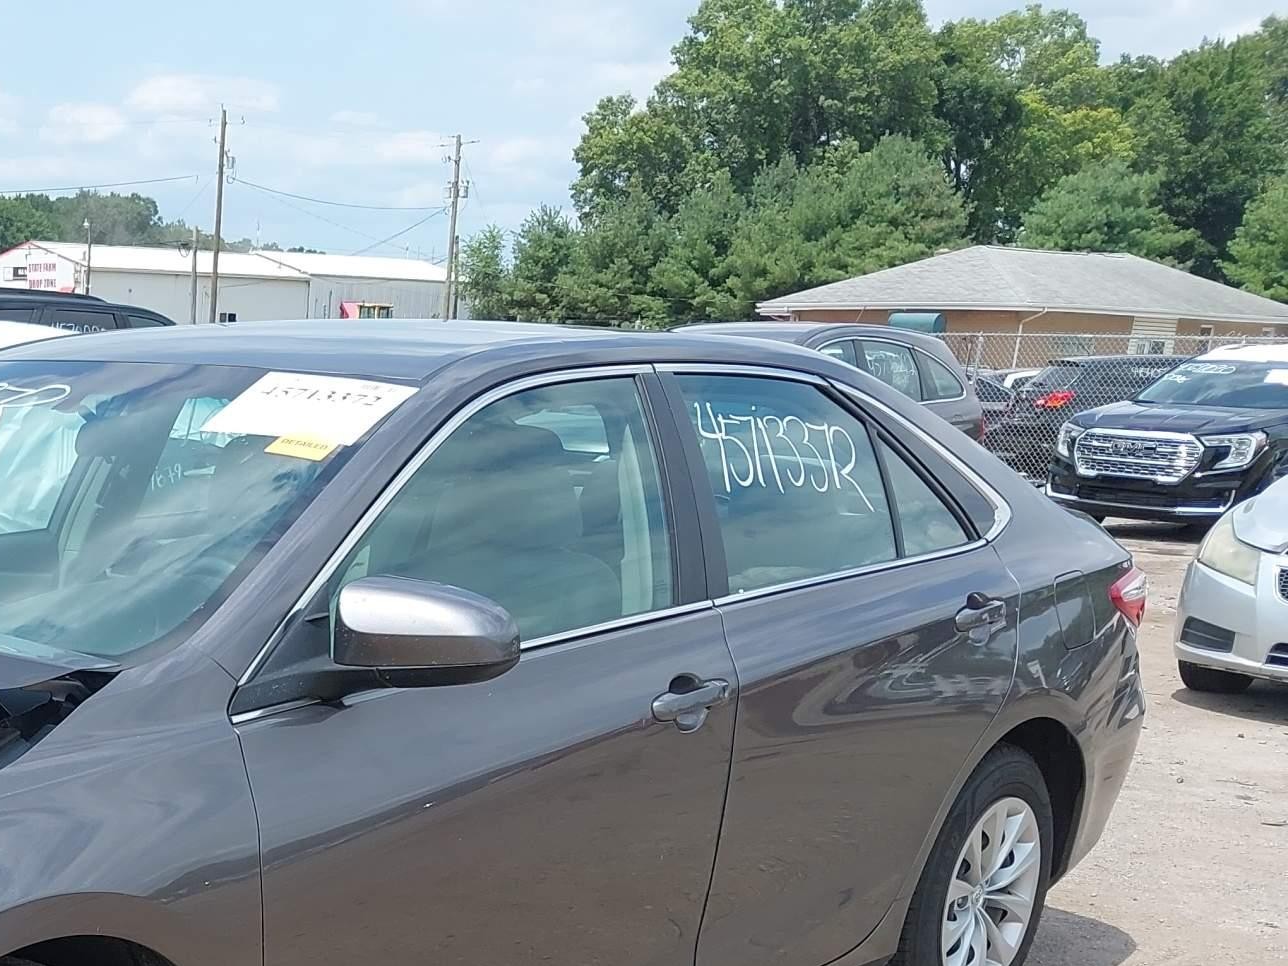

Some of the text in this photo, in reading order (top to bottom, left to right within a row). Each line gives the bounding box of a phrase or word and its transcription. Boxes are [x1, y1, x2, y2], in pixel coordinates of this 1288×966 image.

[28, 263, 57, 273] STATE FARM
[28, 278, 57, 289] DROP ZONE
[279, 437, 329, 451] DETAILED
